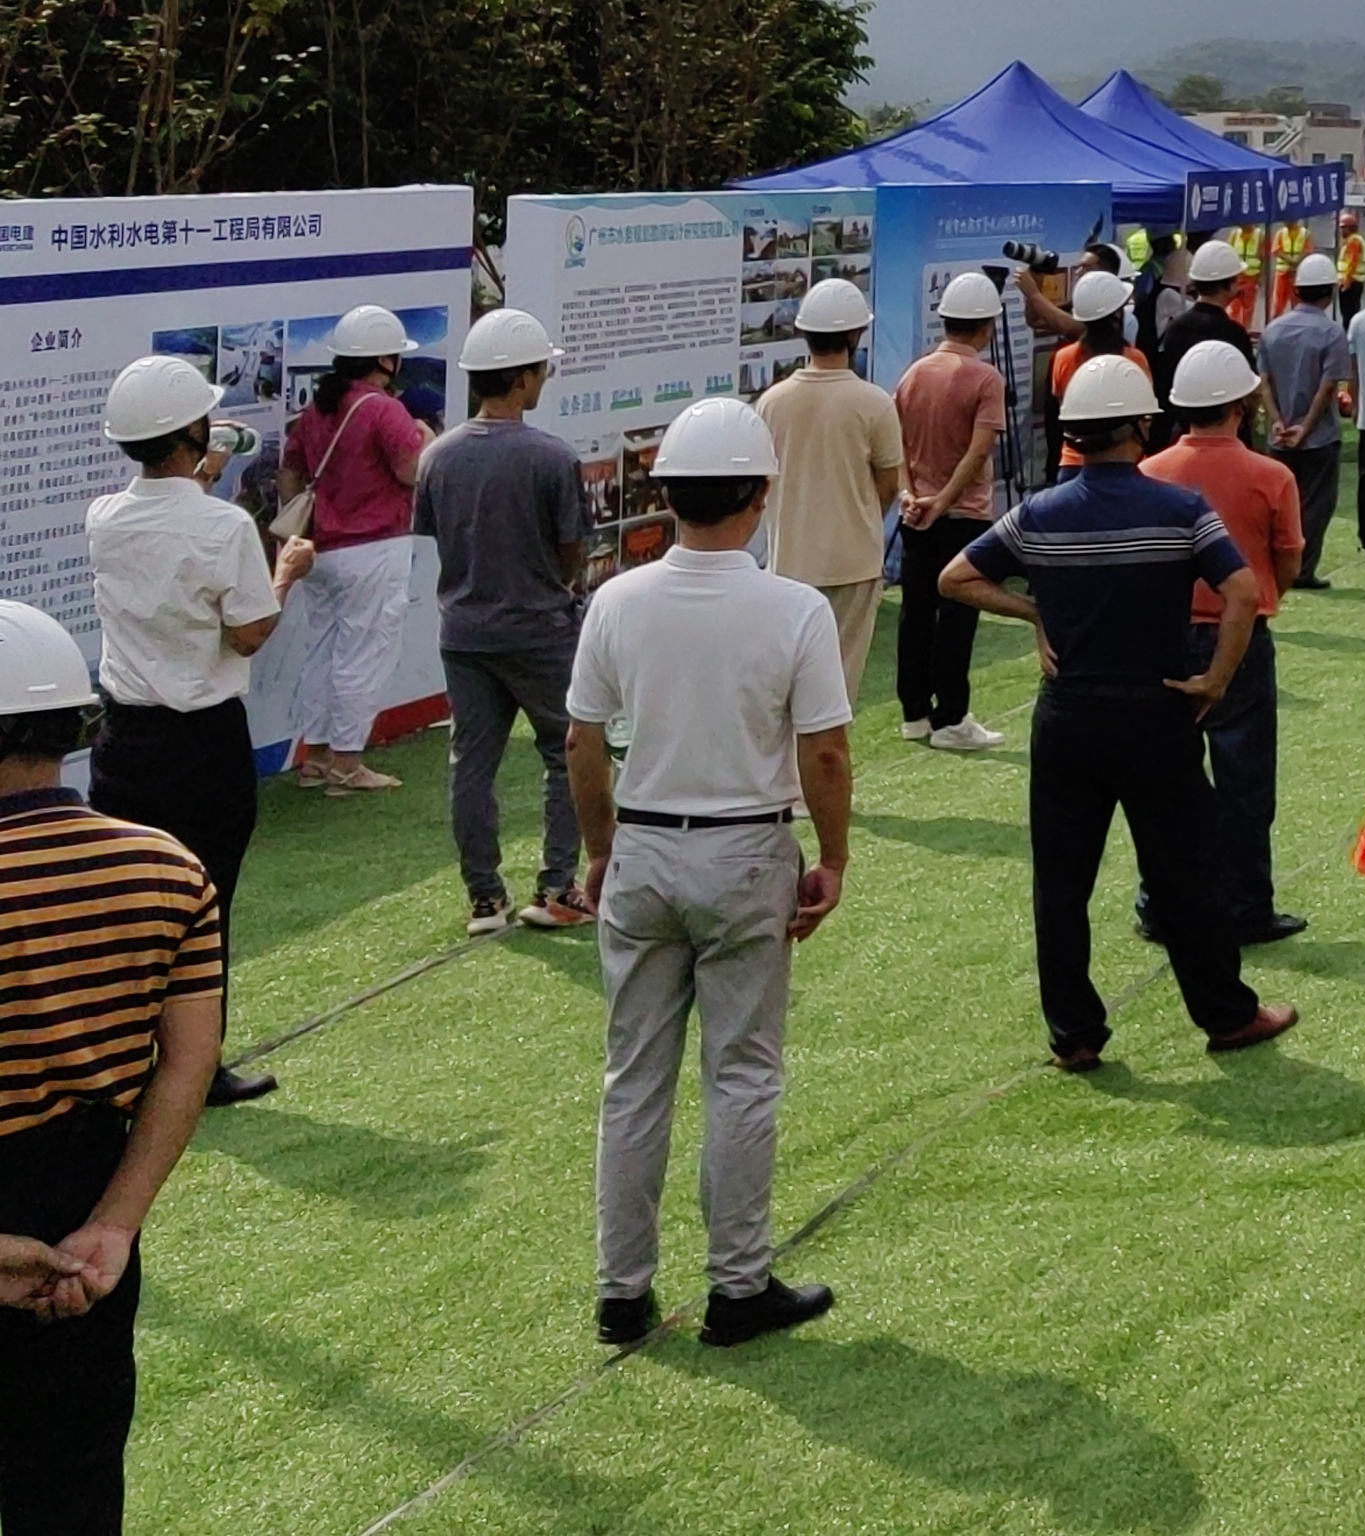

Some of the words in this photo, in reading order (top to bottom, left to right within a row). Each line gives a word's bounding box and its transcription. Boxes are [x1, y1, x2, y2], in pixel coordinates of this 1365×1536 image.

[50, 214, 323, 253] 中国水利水电第十一工程局有限公司
[30, 327, 83, 353] 企业简介
